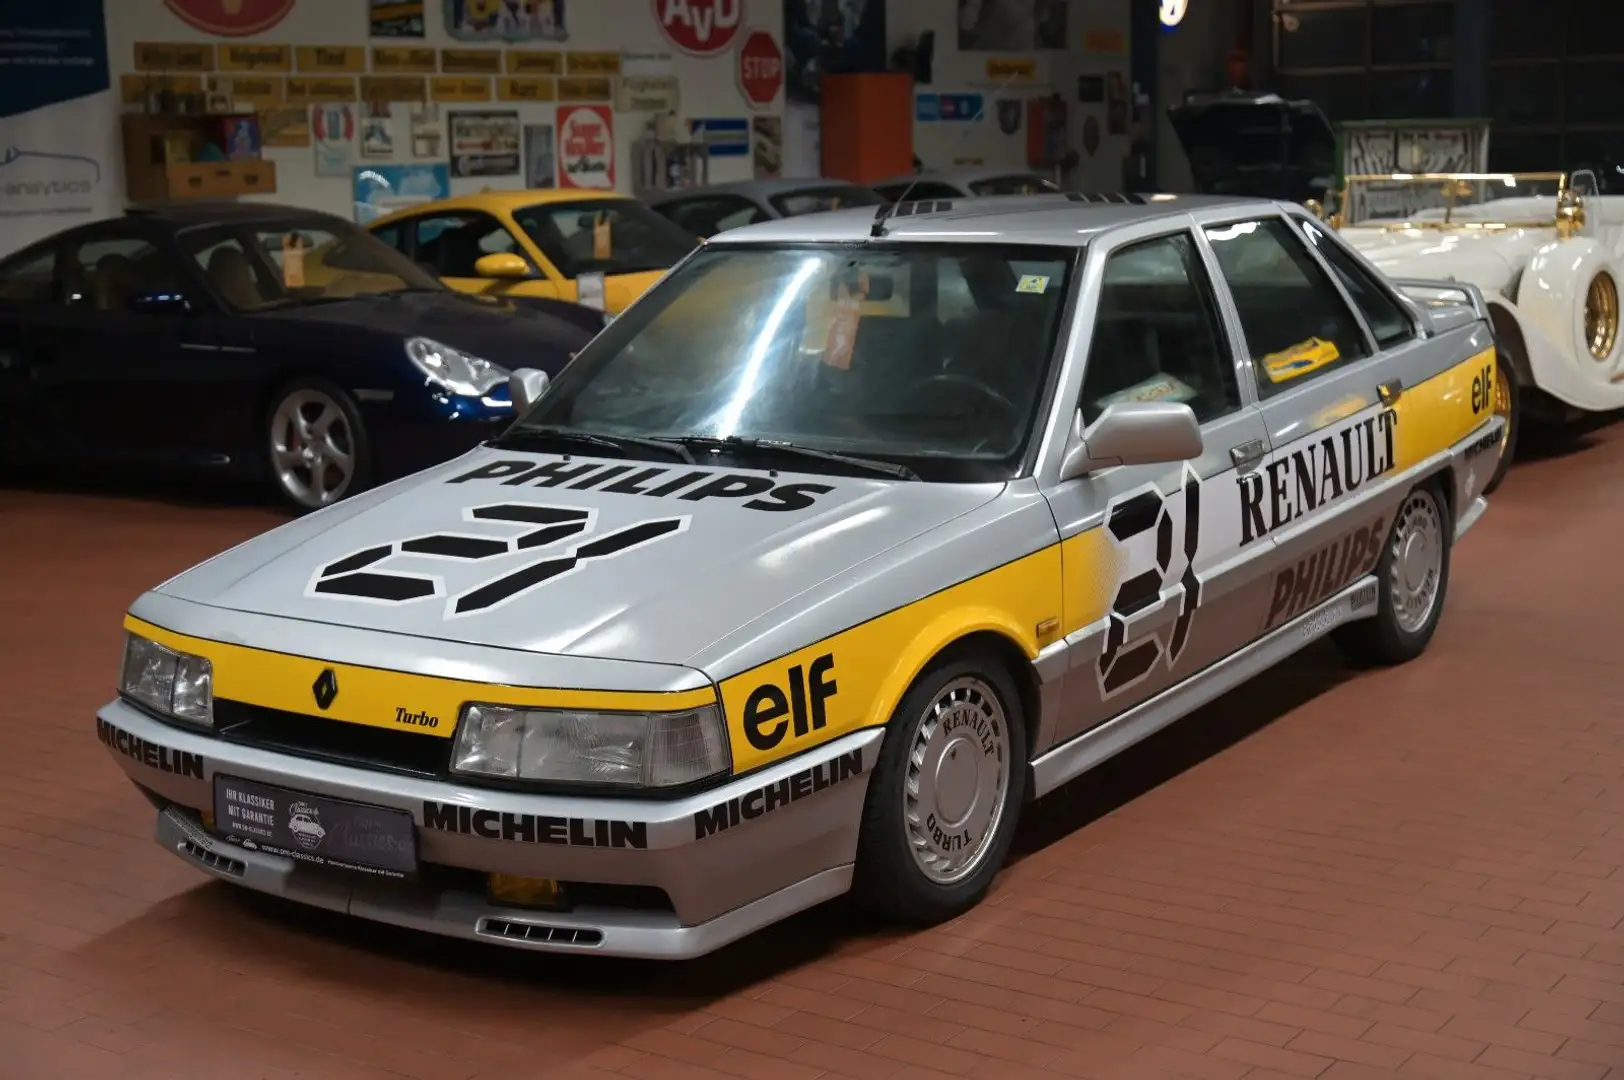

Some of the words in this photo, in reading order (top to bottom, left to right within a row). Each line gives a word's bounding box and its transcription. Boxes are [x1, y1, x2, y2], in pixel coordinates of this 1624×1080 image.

[743, 56, 779, 79] STOP
[1472, 364, 1492, 415] elf
[445, 460, 835, 512] PHILIPS
[1236, 408, 1397, 547] RENAULT
[312, 503, 683, 615] 21
[1098, 465, 1201, 694] 21
[1265, 517, 1385, 630] PHILIPS
[396, 707, 439, 728] Turbo
[743, 653, 838, 750] elf
[97, 716, 205, 780] MICHELIN
[943, 709, 994, 756] RENAULT
[226, 788, 236, 800] IHR
[239, 791, 274, 810] KLASSIKER
[228, 804, 239, 817] MIT
[242, 808, 274, 826] GARANTIE
[694, 747, 863, 841] MICHELIN
[423, 801, 648, 849] MICHELIN
[926, 812, 972, 852] TURBO
